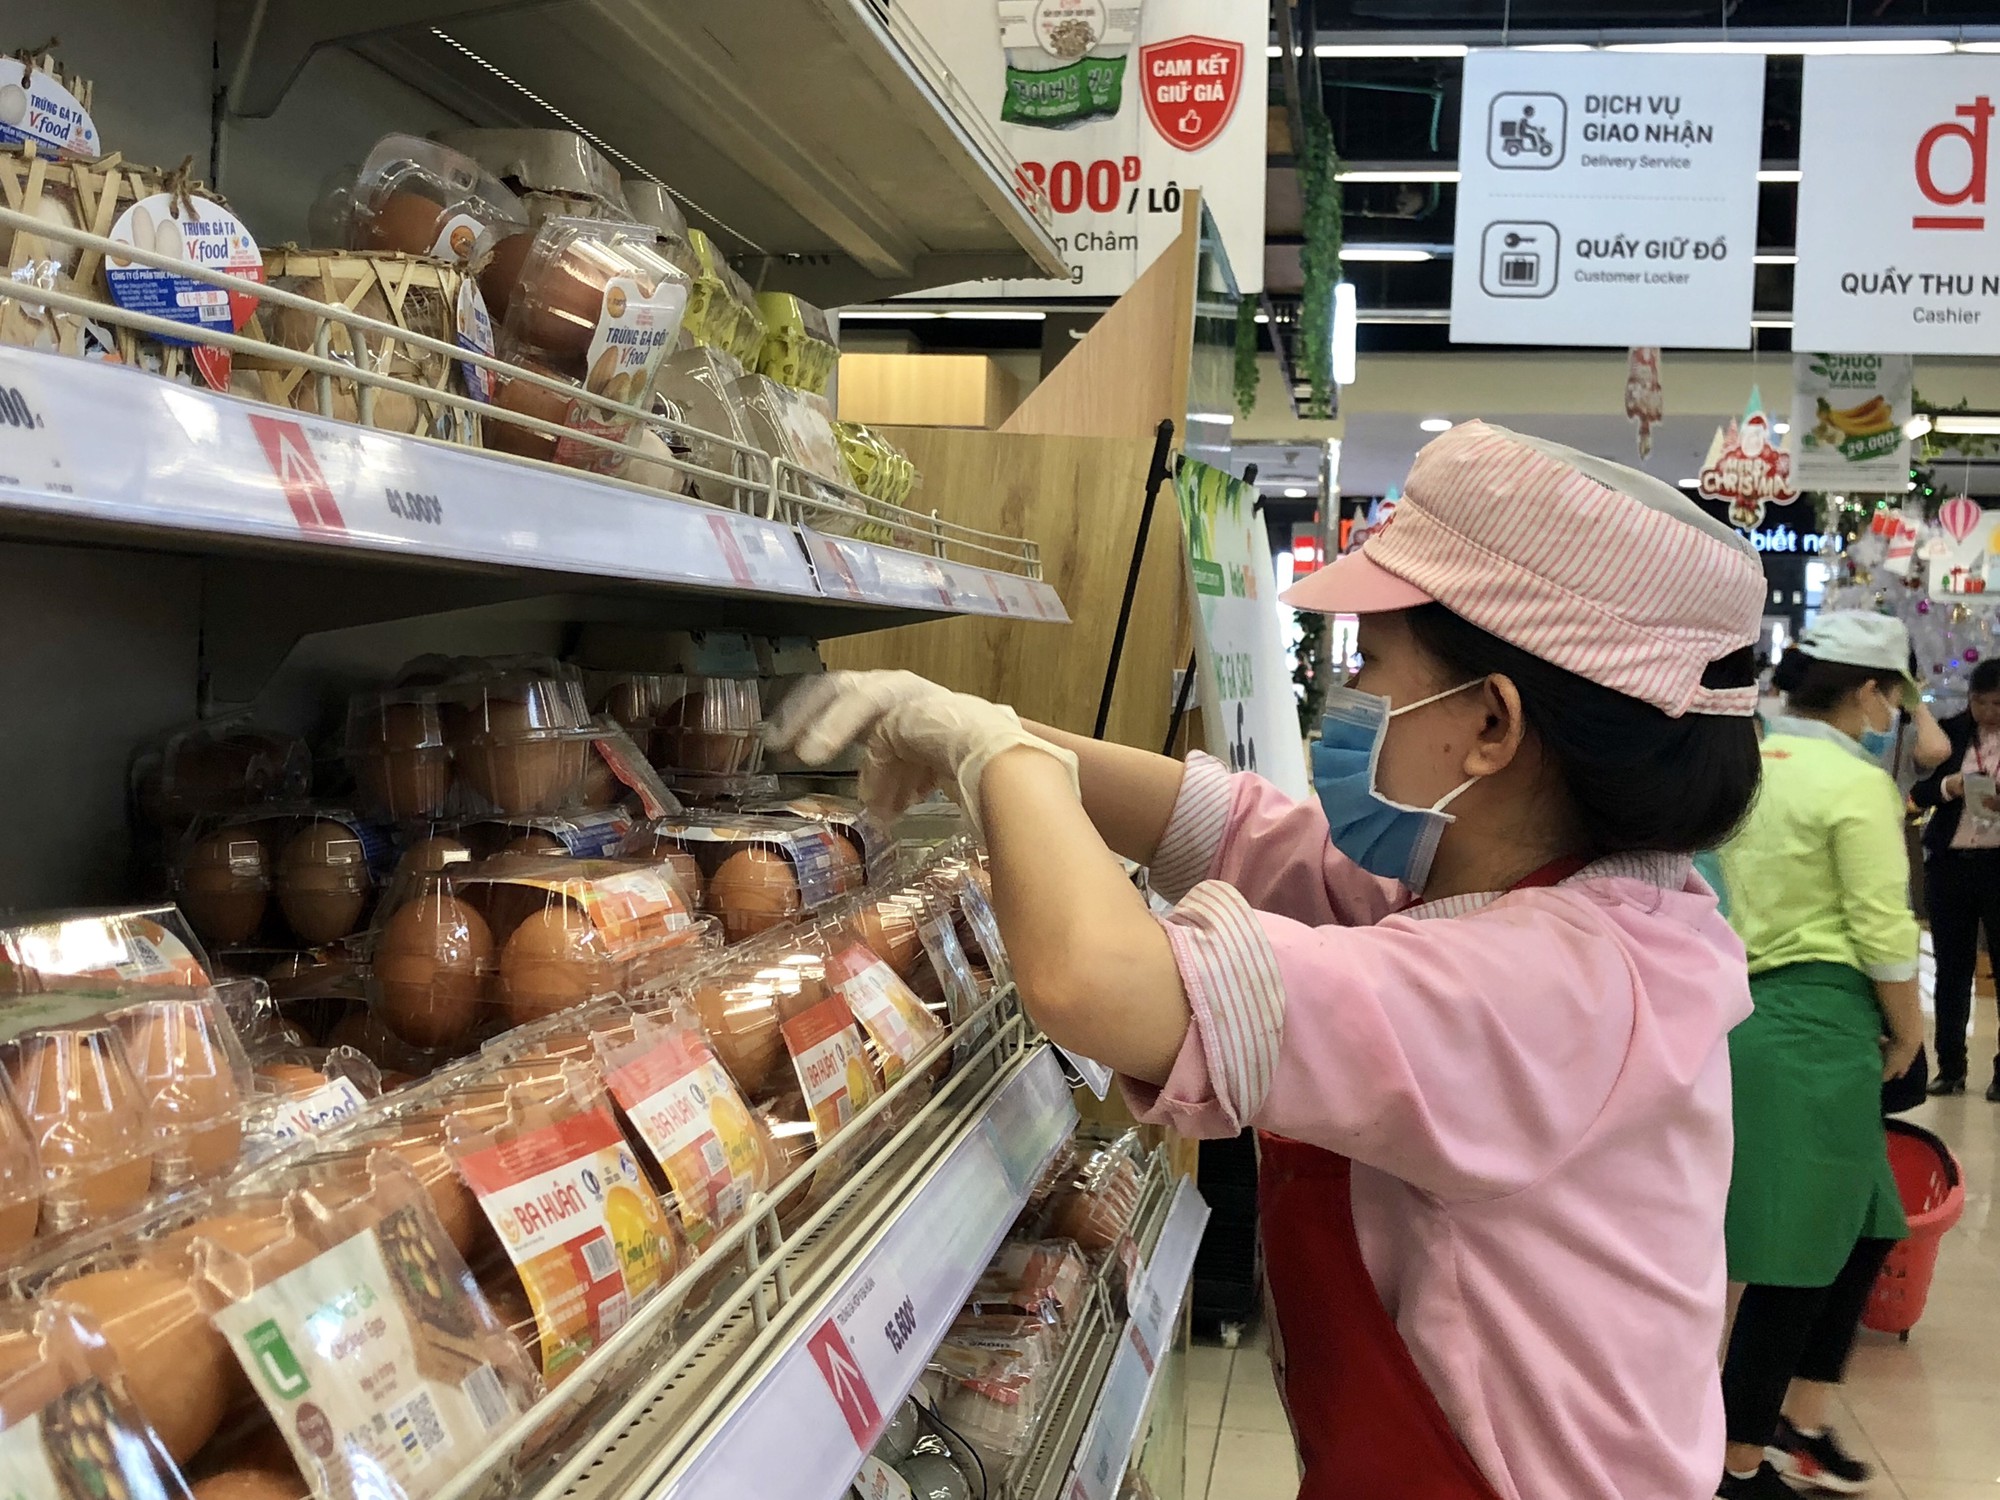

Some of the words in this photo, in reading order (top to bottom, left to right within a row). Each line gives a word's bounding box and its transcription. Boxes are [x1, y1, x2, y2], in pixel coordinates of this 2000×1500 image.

[1153, 59, 1192, 77] CAM
[1196, 52, 1230, 76] KẾT
[1157, 81, 1192, 103] GIỮ
[1193, 79, 1225, 102] GIÁ
[30, 94, 58, 116] TRỨNG
[59, 106, 70, 121] GÀ
[72, 111, 83, 126] TA
[1584, 94, 1641, 119] DỊCH
[1647, 95, 1681, 120] VỤ
[1583, 123, 1640, 142] GIAO
[1645, 120, 1713, 149] NHẬN
[1580, 154, 1637, 170] Delivery
[1639, 155, 1691, 170] Service
[1148, 181, 1181, 214] LÔ
[212, 218, 225, 236] GÀ
[225, 222, 236, 236] TA
[186, 237, 229, 263] V.food
[1074, 231, 1139, 252] Châm
[1645, 236, 1690, 260] GIỮ
[1692, 235, 1728, 261] ĐỒ
[1574, 269, 1641, 284] Customer
[1643, 270, 1690, 285] Locker
[1919, 274, 1974, 296] THU
[1912, 306, 1981, 325] Cashier
[606, 326, 640, 346] TRỨNG
[639, 327, 654, 347] GÀ
[1750, 524, 1798, 552] biết
[513, 1200, 547, 1236] BA
[537, 1180, 588, 1226] HUÂN
[262, 1351, 302, 1391] L
